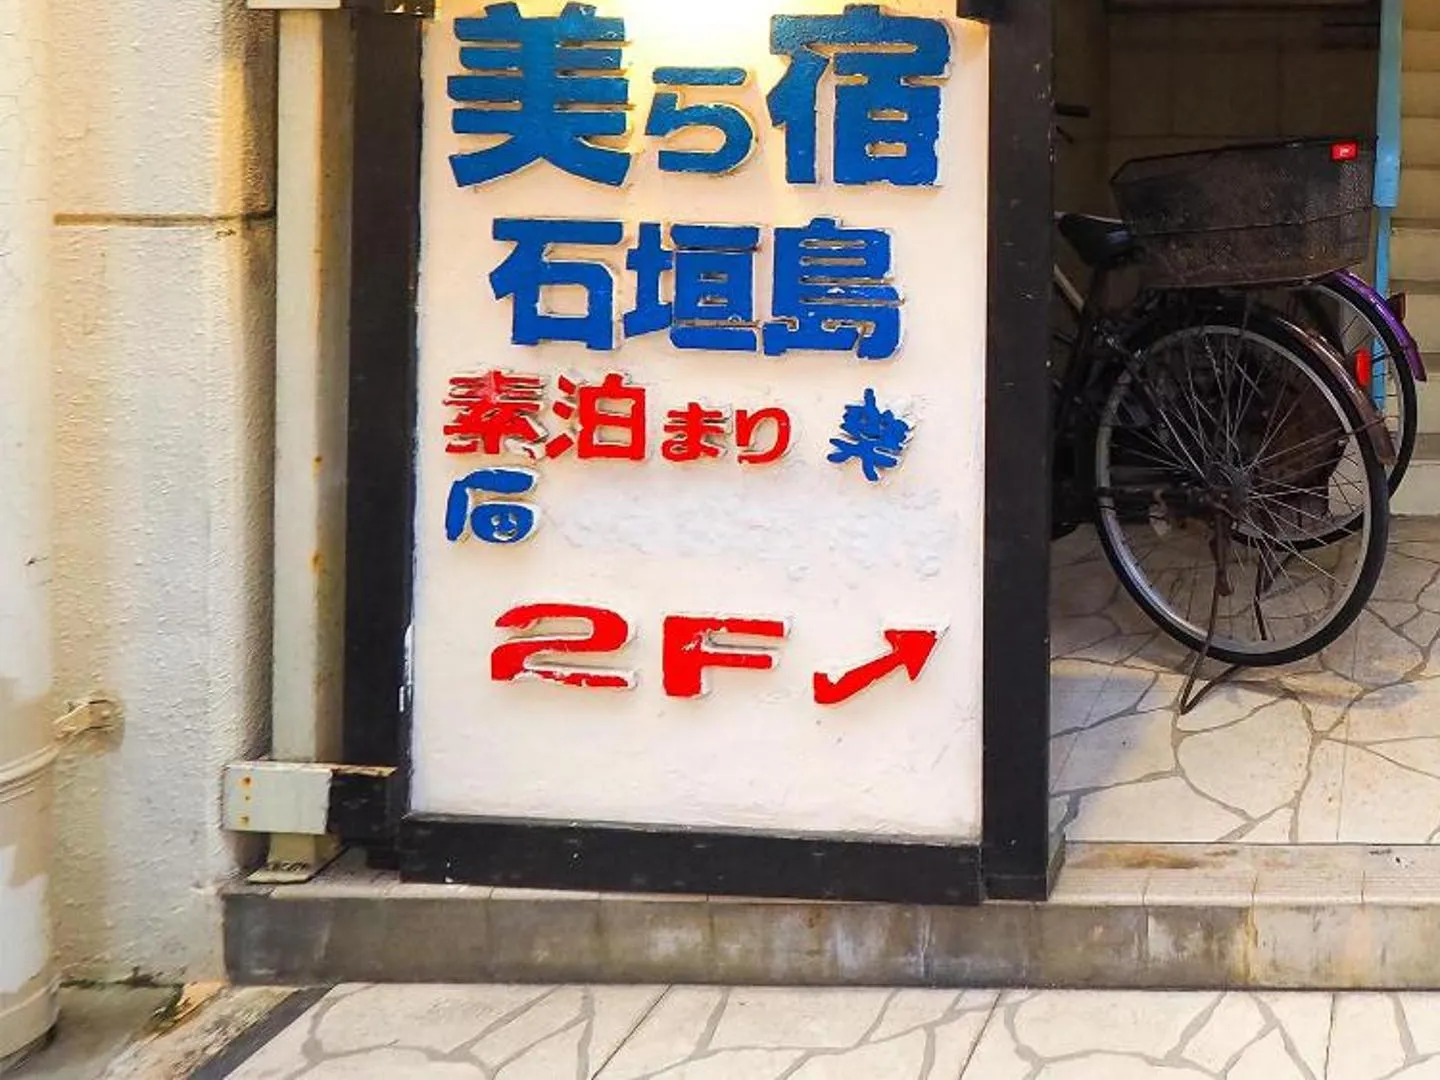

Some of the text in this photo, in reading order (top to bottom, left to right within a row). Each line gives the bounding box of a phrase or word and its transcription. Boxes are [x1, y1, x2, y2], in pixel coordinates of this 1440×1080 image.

[447, 2, 952, 188] 美ら宿
[489, 217, 904, 360] 石垣島
[442, 370, 792, 465] 素泊まり
[490, 603, 788, 699] 2F
